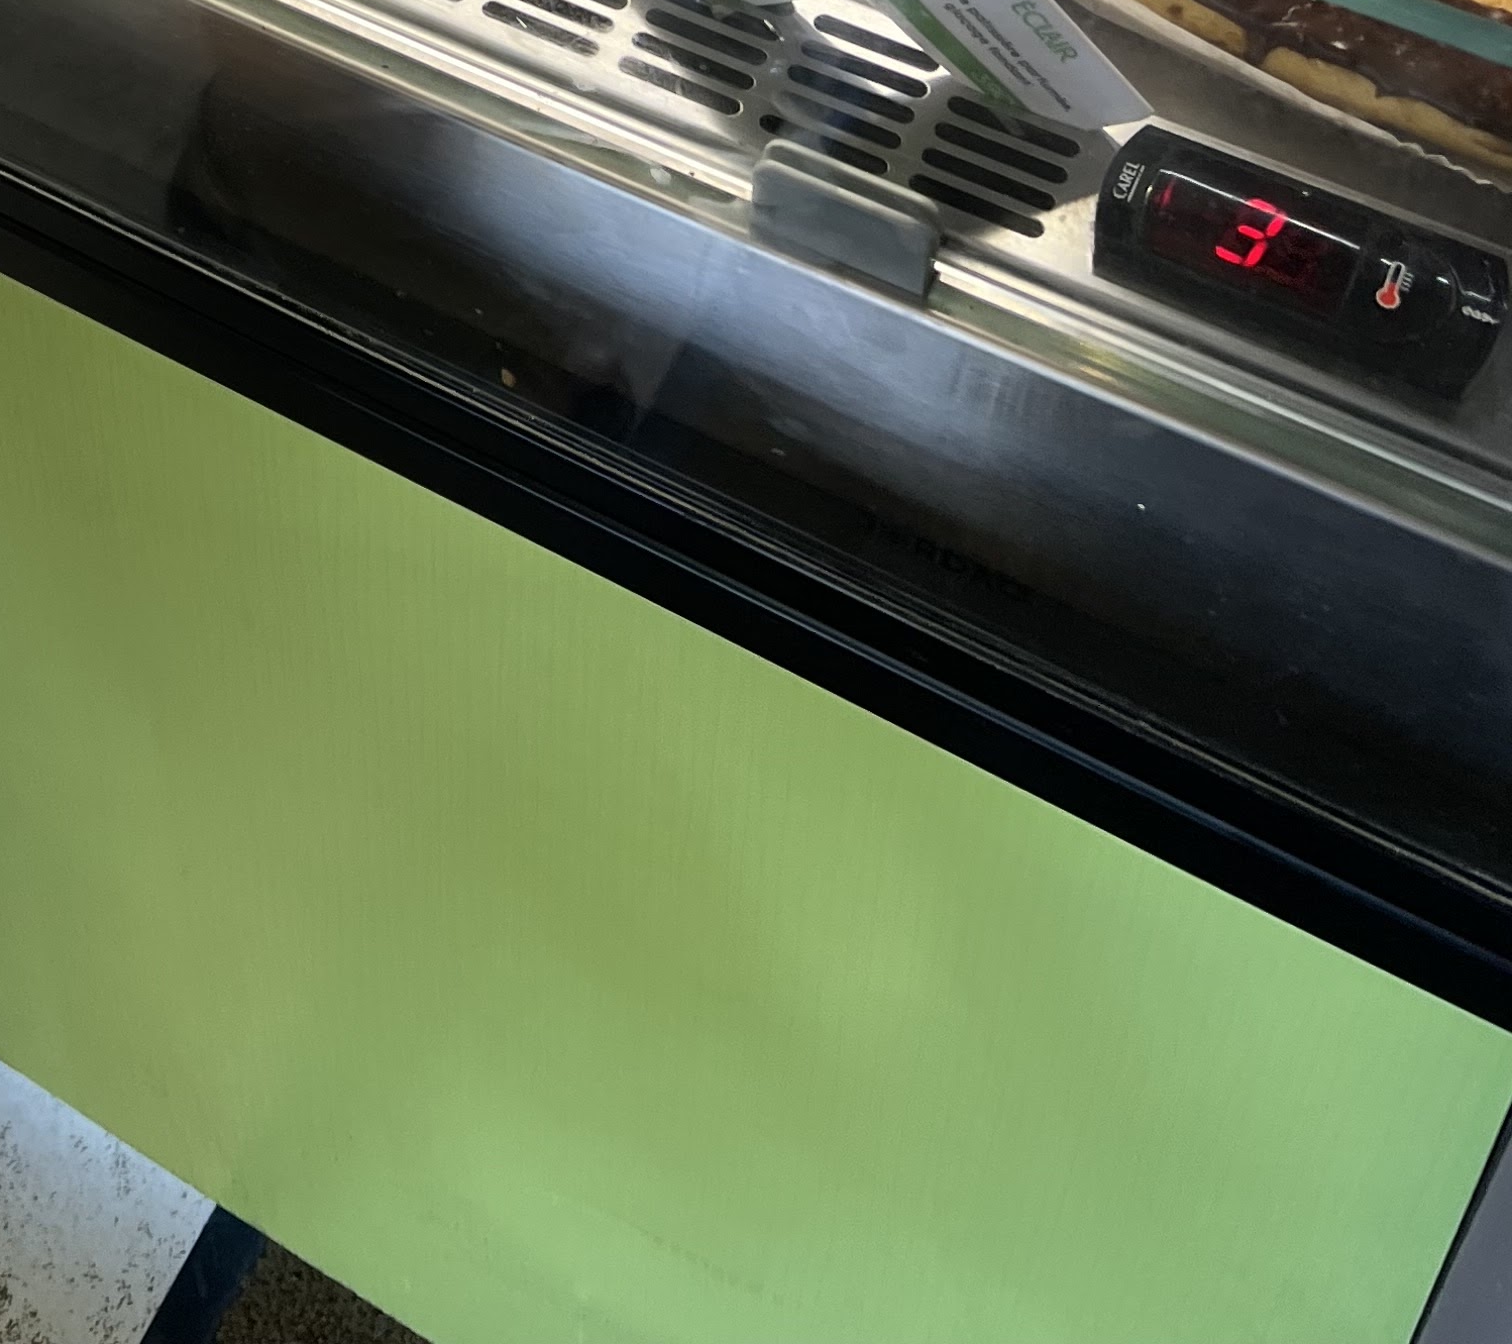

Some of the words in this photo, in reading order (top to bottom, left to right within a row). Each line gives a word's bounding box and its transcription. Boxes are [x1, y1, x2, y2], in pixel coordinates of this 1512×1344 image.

[1011, 0, 1078, 63] ÉCLAIR
[1113, 161, 1141, 199] CAREL
[1215, 198, 1287, 267] 3
